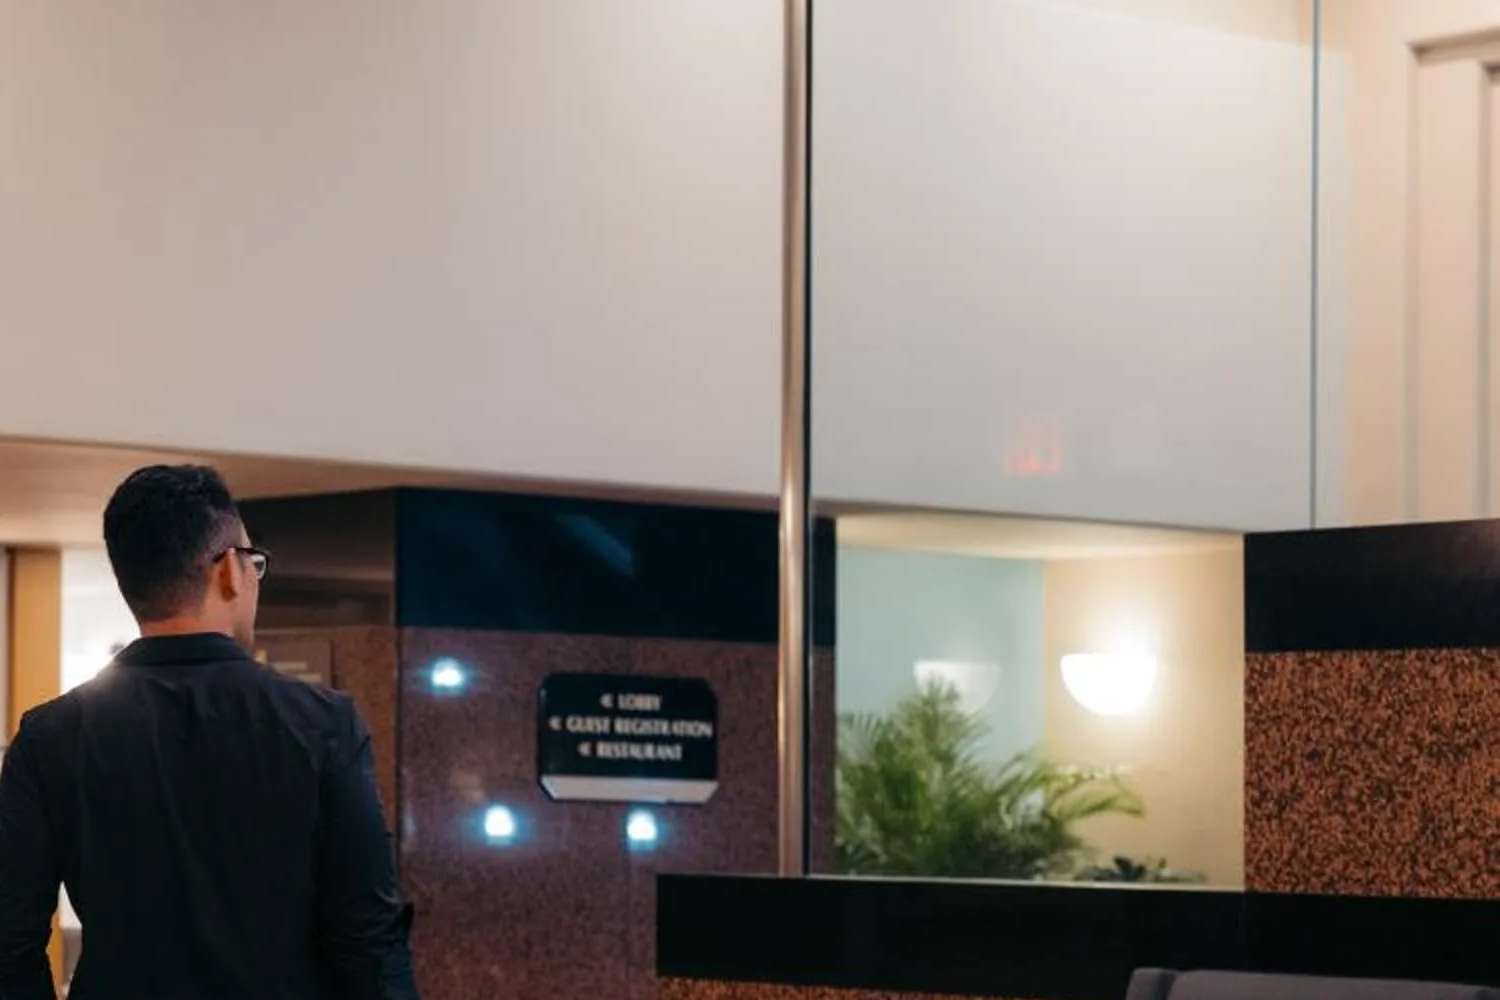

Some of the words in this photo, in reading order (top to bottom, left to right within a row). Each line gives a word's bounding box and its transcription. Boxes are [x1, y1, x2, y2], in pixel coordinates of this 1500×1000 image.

[618, 694, 661, 710] LOBBY
[566, 716, 610, 733] GUEST
[615, 718, 713, 737] REGISTRATION
[597, 742, 683, 760] RESTAURANT
